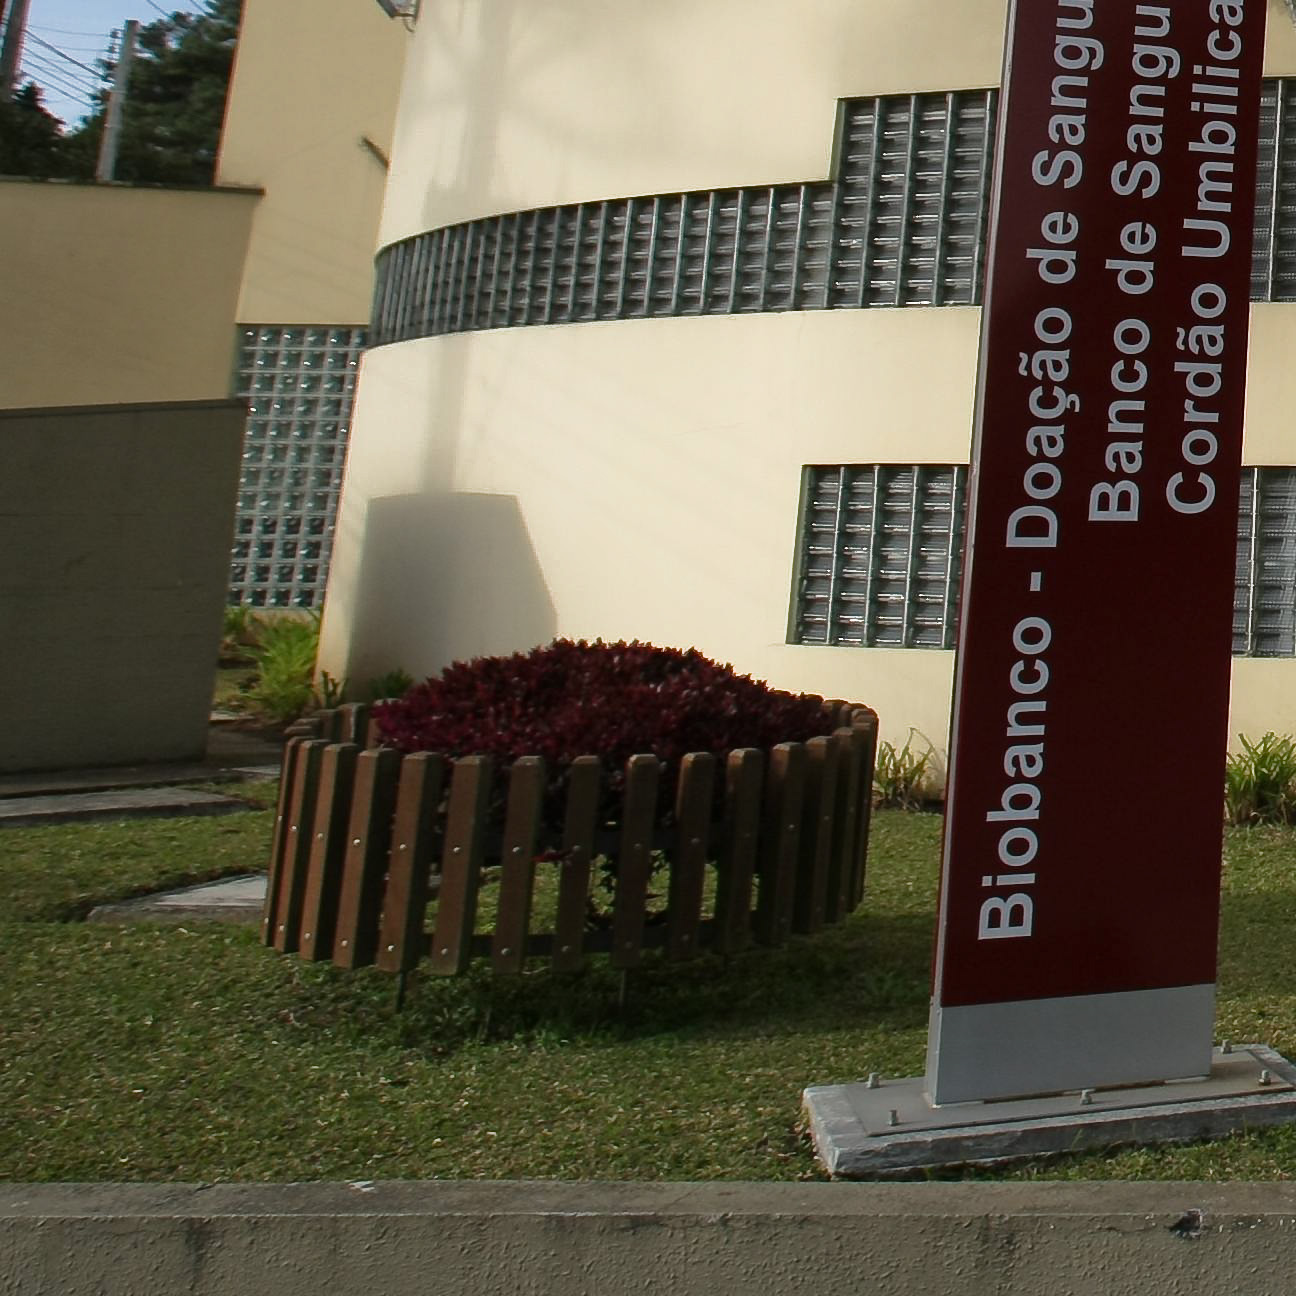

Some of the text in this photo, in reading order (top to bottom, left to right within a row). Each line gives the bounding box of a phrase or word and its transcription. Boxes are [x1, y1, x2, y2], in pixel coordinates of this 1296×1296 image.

[1026, 210, 1080, 285] de
[1105, 221, 1157, 296] de
[1005, 307, 1081, 549] Doação
[1087, 318, 1151, 523] Banco
[1165, 283, 1227, 514] Cordão
[977, 616, 1053, 941] Biobanco
